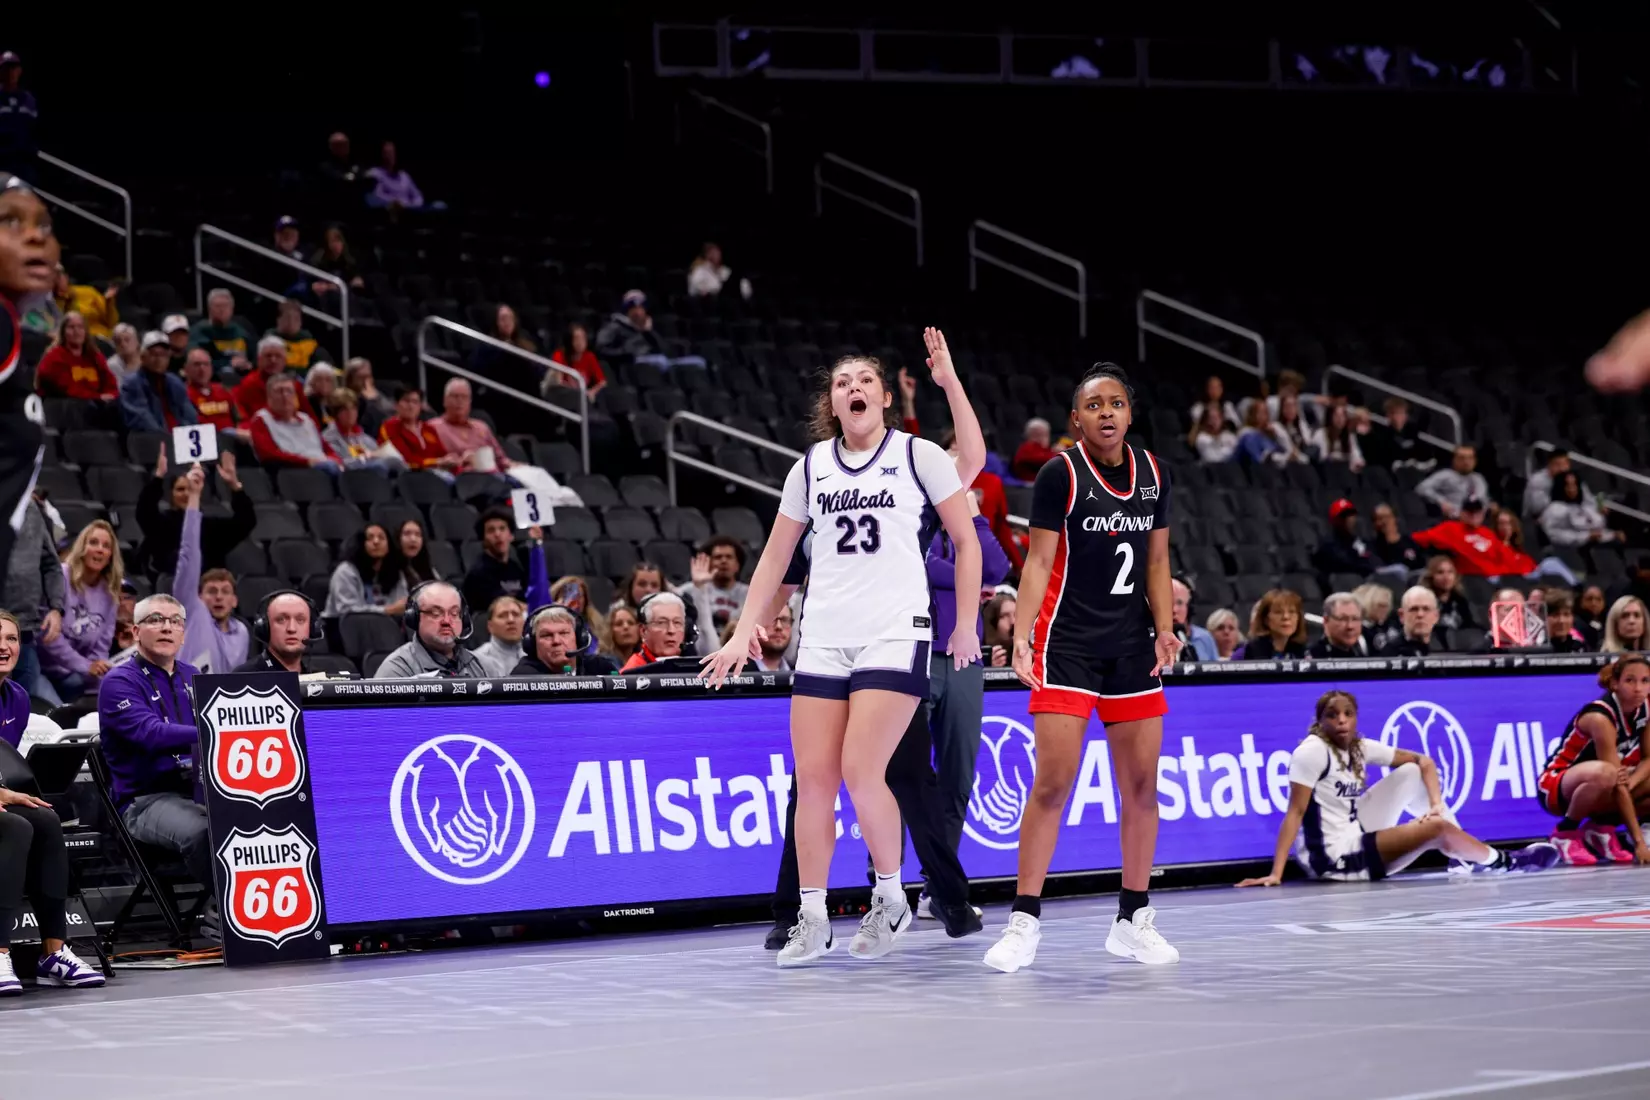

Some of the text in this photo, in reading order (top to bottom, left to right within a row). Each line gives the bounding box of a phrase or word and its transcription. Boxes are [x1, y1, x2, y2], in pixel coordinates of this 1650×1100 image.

[189, 430, 202, 457] 3
[526, 493, 540, 522] 3
[816, 488, 896, 515] Wildcats
[835, 514, 881, 555] 23
[1110, 542, 1135, 595] 2
[335, 684, 443, 694] OFFICIAL GLASS CLEANING PARTNER
[503, 683, 529, 692] OFFICIAL
[530, 682, 549, 691] GLASS
[549, 681, 577, 691] CLEANING
[578, 680, 603, 690] PARTNER
[660, 678, 685, 687] OFFICIAL
[685, 677, 703, 686] GLASS
[217, 705, 285, 726] PHILLIPS
[227, 736, 284, 780] 66
[1481, 721, 1562, 801] All
[1066, 734, 1291, 826] Astate
[233, 843, 302, 866] PHILLIPS
[243, 875, 300, 920] 66
[603, 907, 655, 917] DAKTRONICS
